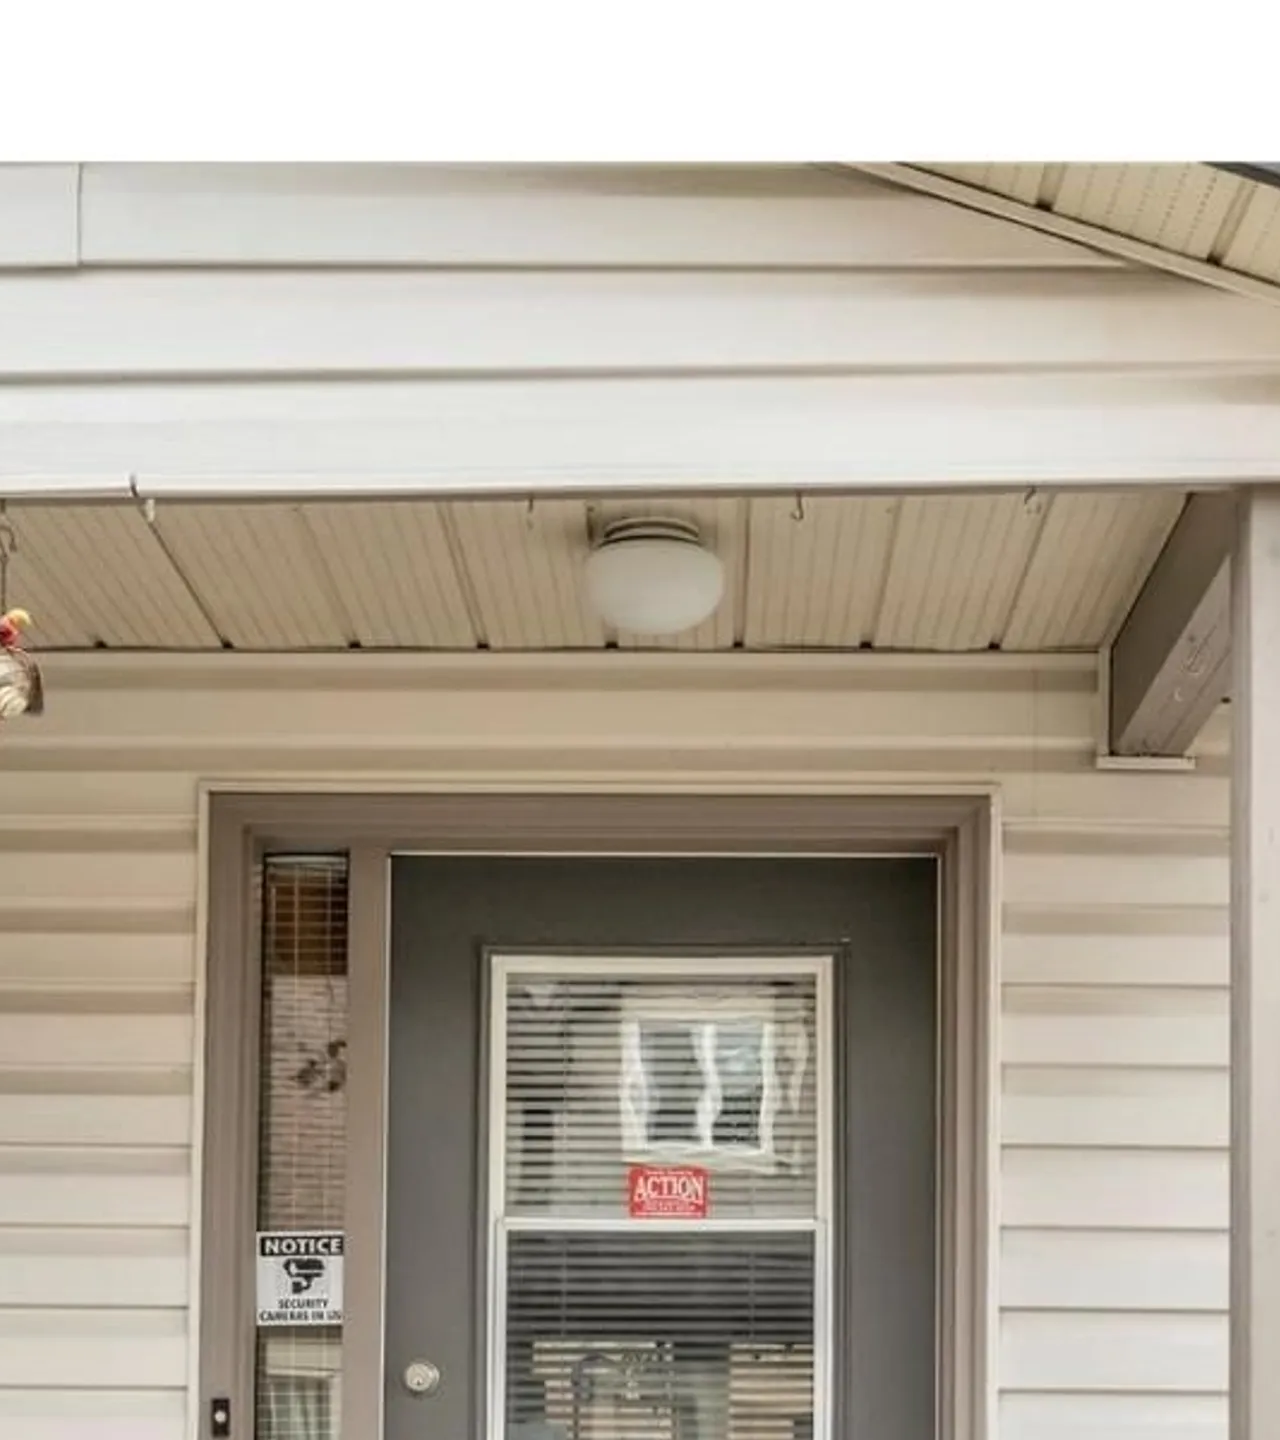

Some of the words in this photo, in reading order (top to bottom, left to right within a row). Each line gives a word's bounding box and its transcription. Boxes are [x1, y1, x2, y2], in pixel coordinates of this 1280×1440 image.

[632, 1175, 705, 1205] ACTION
[264, 1238, 341, 1254] NOTICE
[277, 1298, 328, 1309] SECURITY
[260, 1310, 308, 1321] CAMERAS
[311, 1310, 324, 1320] IN
